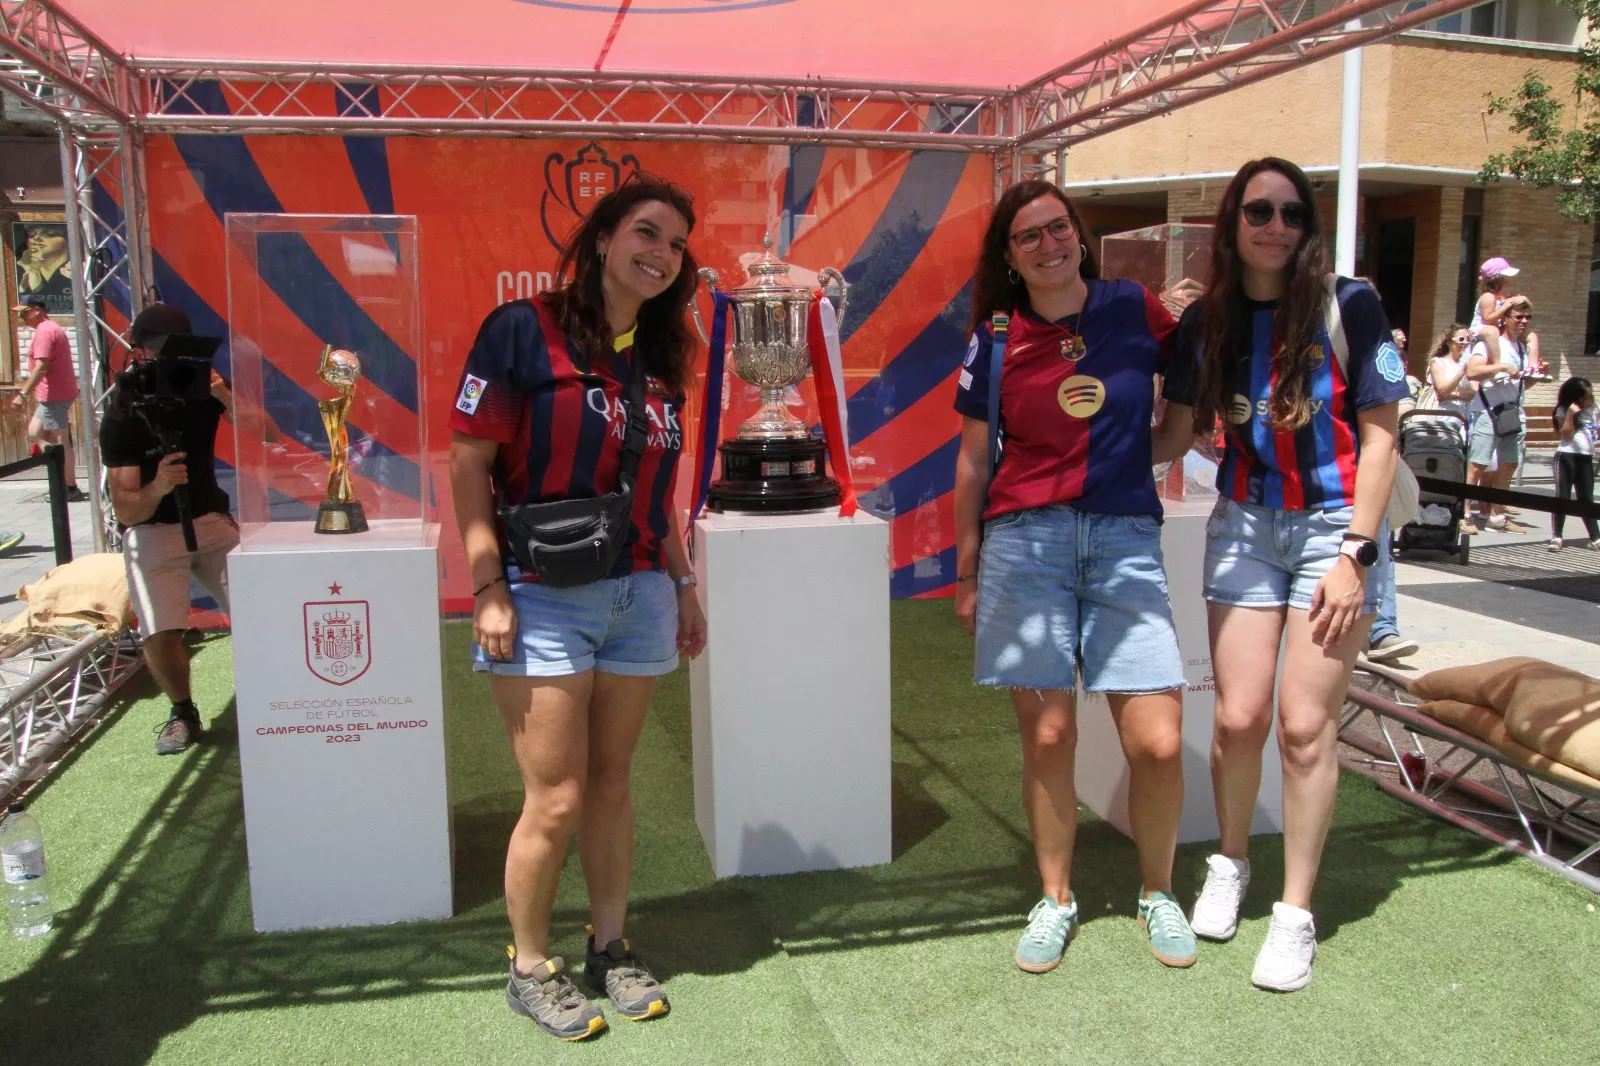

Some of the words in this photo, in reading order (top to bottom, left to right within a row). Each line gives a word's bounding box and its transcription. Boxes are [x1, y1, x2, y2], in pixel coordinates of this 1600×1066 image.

[586, 387, 680, 431] QAAR
[269, 697, 343, 711] SELECCIÓN
[346, 696, 413, 707] ESPAÑOLA
[306, 711, 323, 720] DE
[327, 708, 378, 719] FÚTBOL
[256, 723, 344, 736] CAMPEONAS
[347, 722, 374, 731] DEL
[376, 719, 428, 730] MUNDO
[326, 734, 361, 743] 2023
